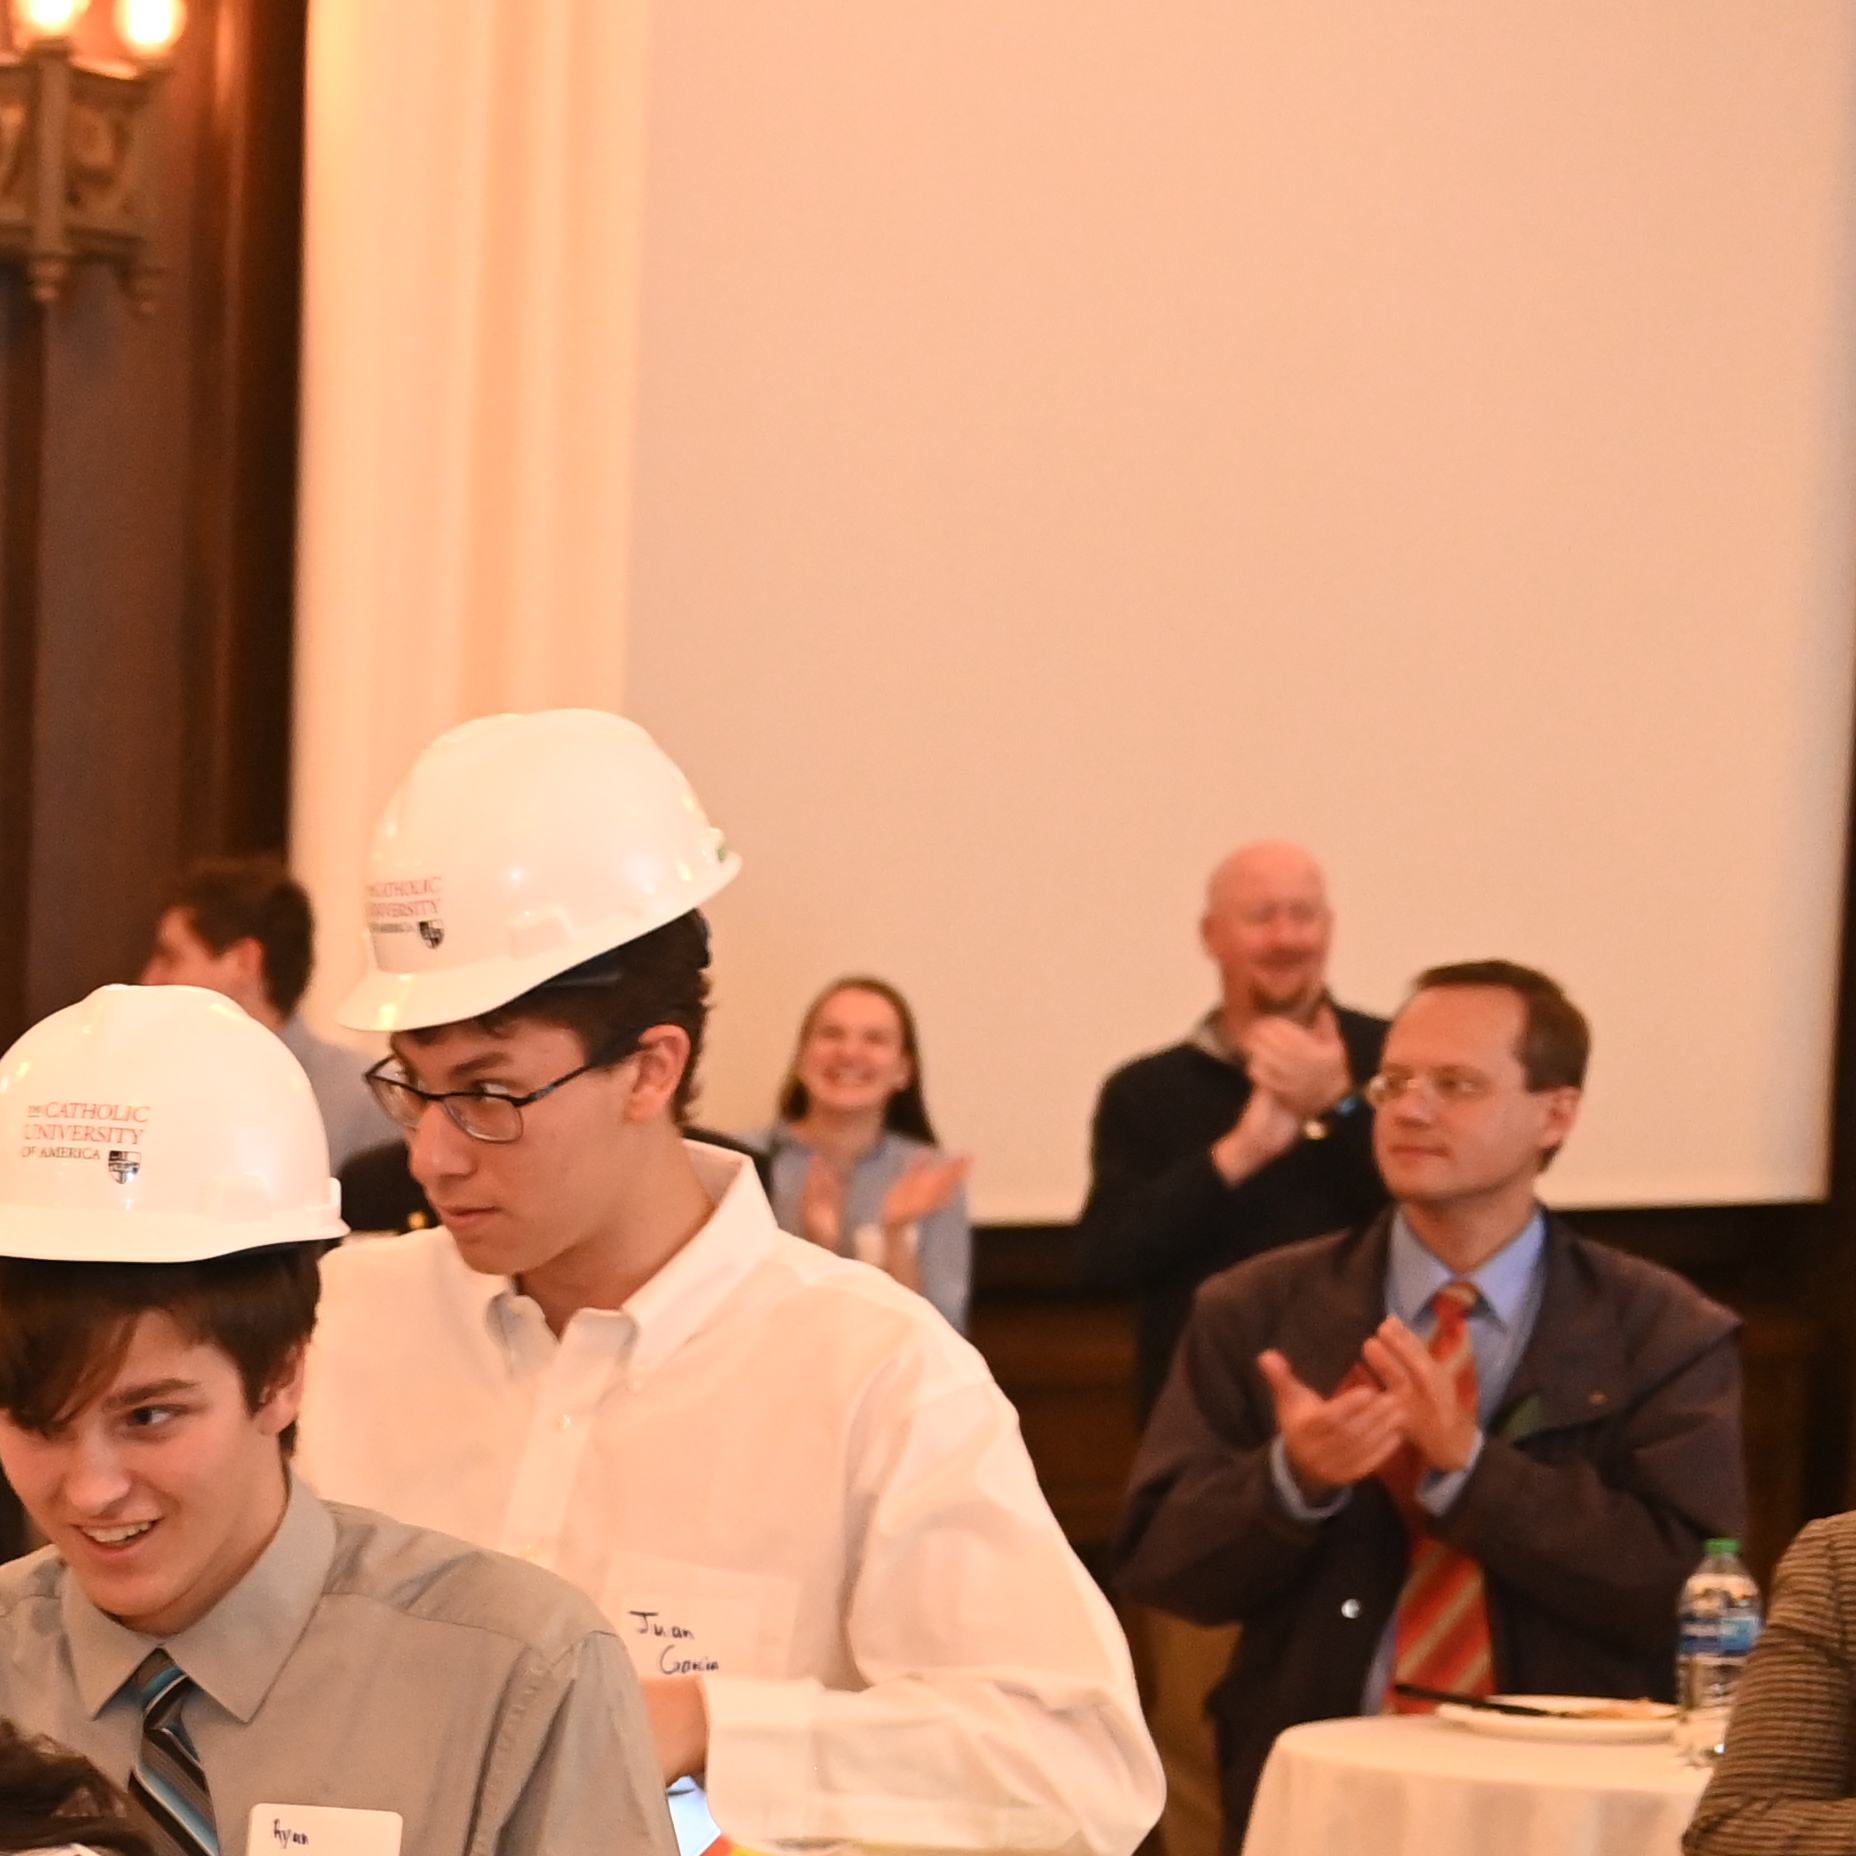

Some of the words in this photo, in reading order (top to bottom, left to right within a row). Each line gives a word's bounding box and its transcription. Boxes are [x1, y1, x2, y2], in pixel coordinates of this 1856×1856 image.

[45, 1101, 151, 1123] CATHOLIC
[23, 1123, 145, 1145] UNIVERSITY
[20, 1146, 37, 1158] OF
[39, 1146, 101, 1160] AMERICA
[629, 1610, 695, 1640] Juan
